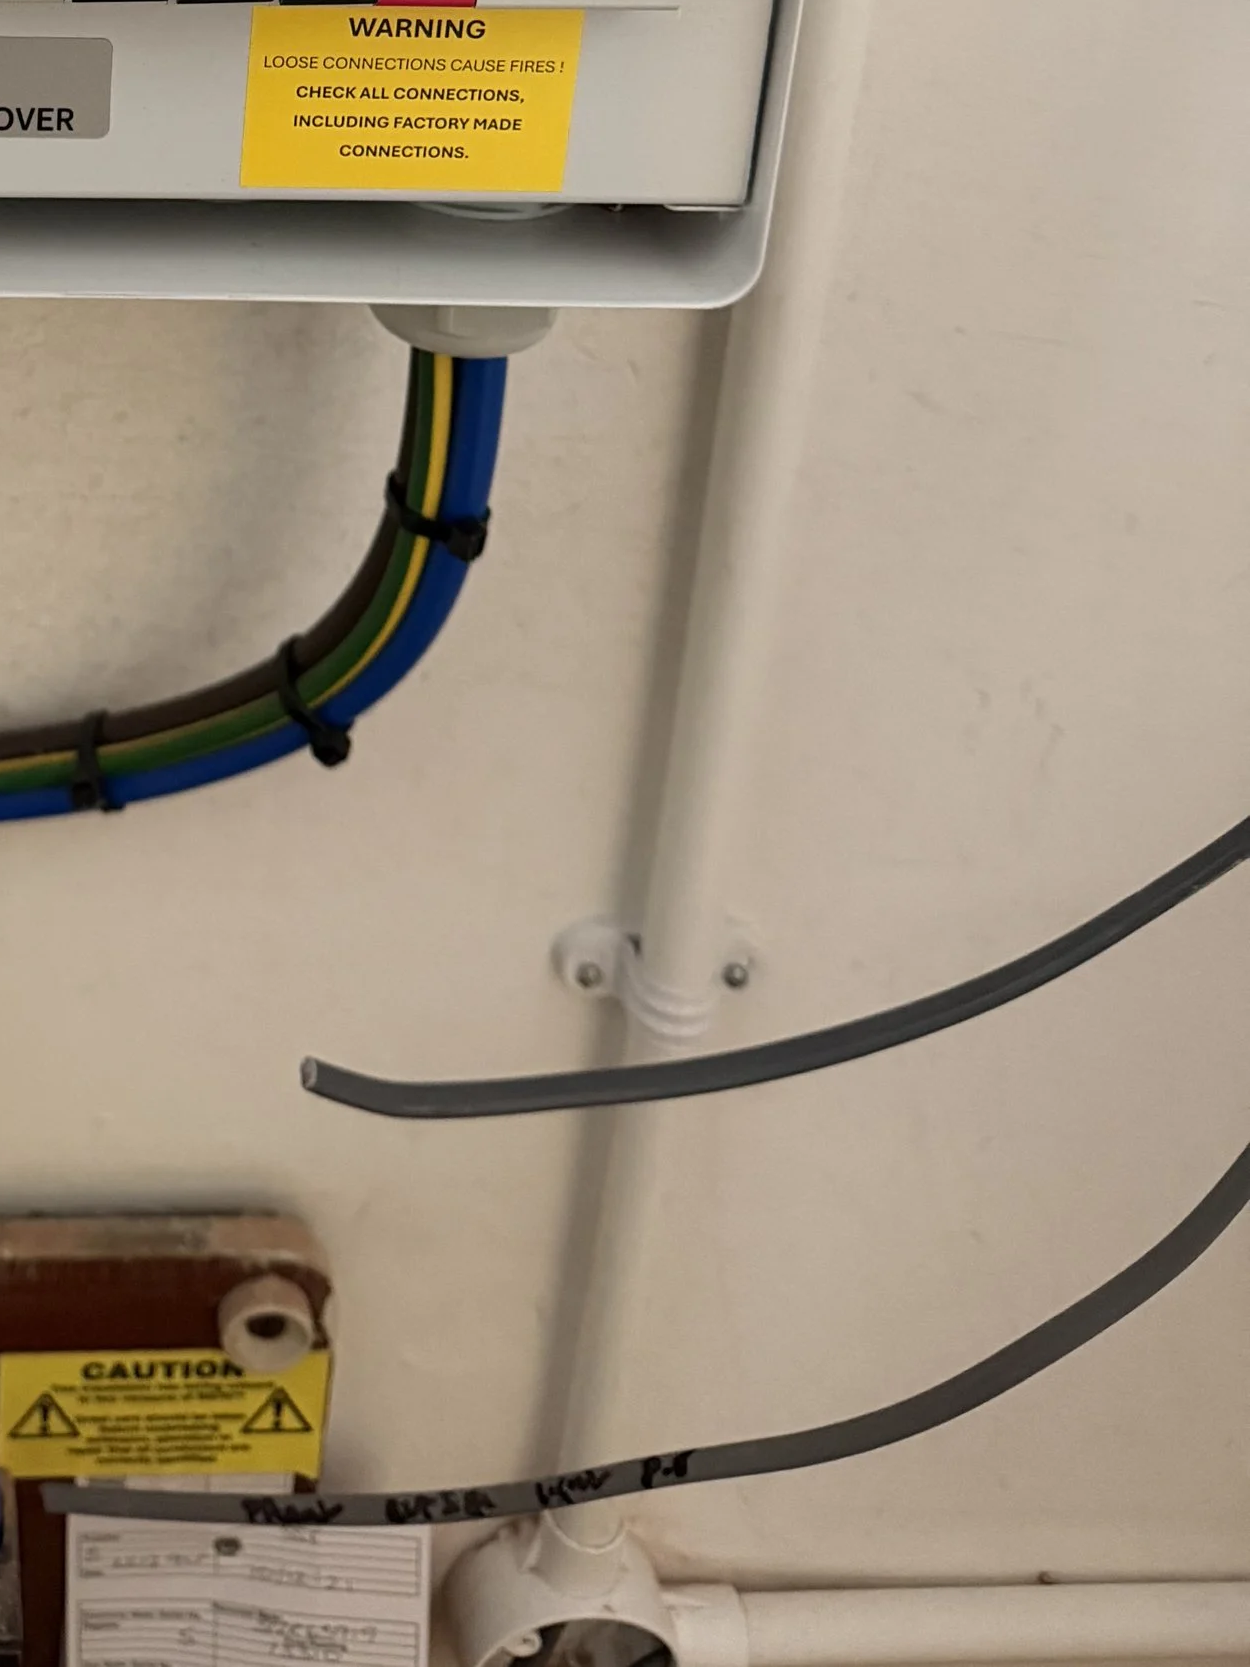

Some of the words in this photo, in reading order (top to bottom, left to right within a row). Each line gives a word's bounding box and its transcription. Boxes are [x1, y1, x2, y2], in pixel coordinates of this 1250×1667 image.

[349, 17, 487, 40] WARNING
[263, 55, 319, 70] LOOSE
[322, 56, 447, 72] CONNECTIONS
[450, 58, 506, 73] CAUSE
[509, 59, 556, 74] FIRES
[296, 86, 357, 100] CHECK
[359, 86, 390, 101] ALL
[393, 87, 526, 104] CONNECTIONS,
[293, 114, 389, 129] INCLUDING
[393, 116, 470, 131] FACTORY
[473, 117, 523, 132] MADE
[339, 144, 470, 160] CONNECTIONS.
[80, 1360, 246, 1381] CAUTION
